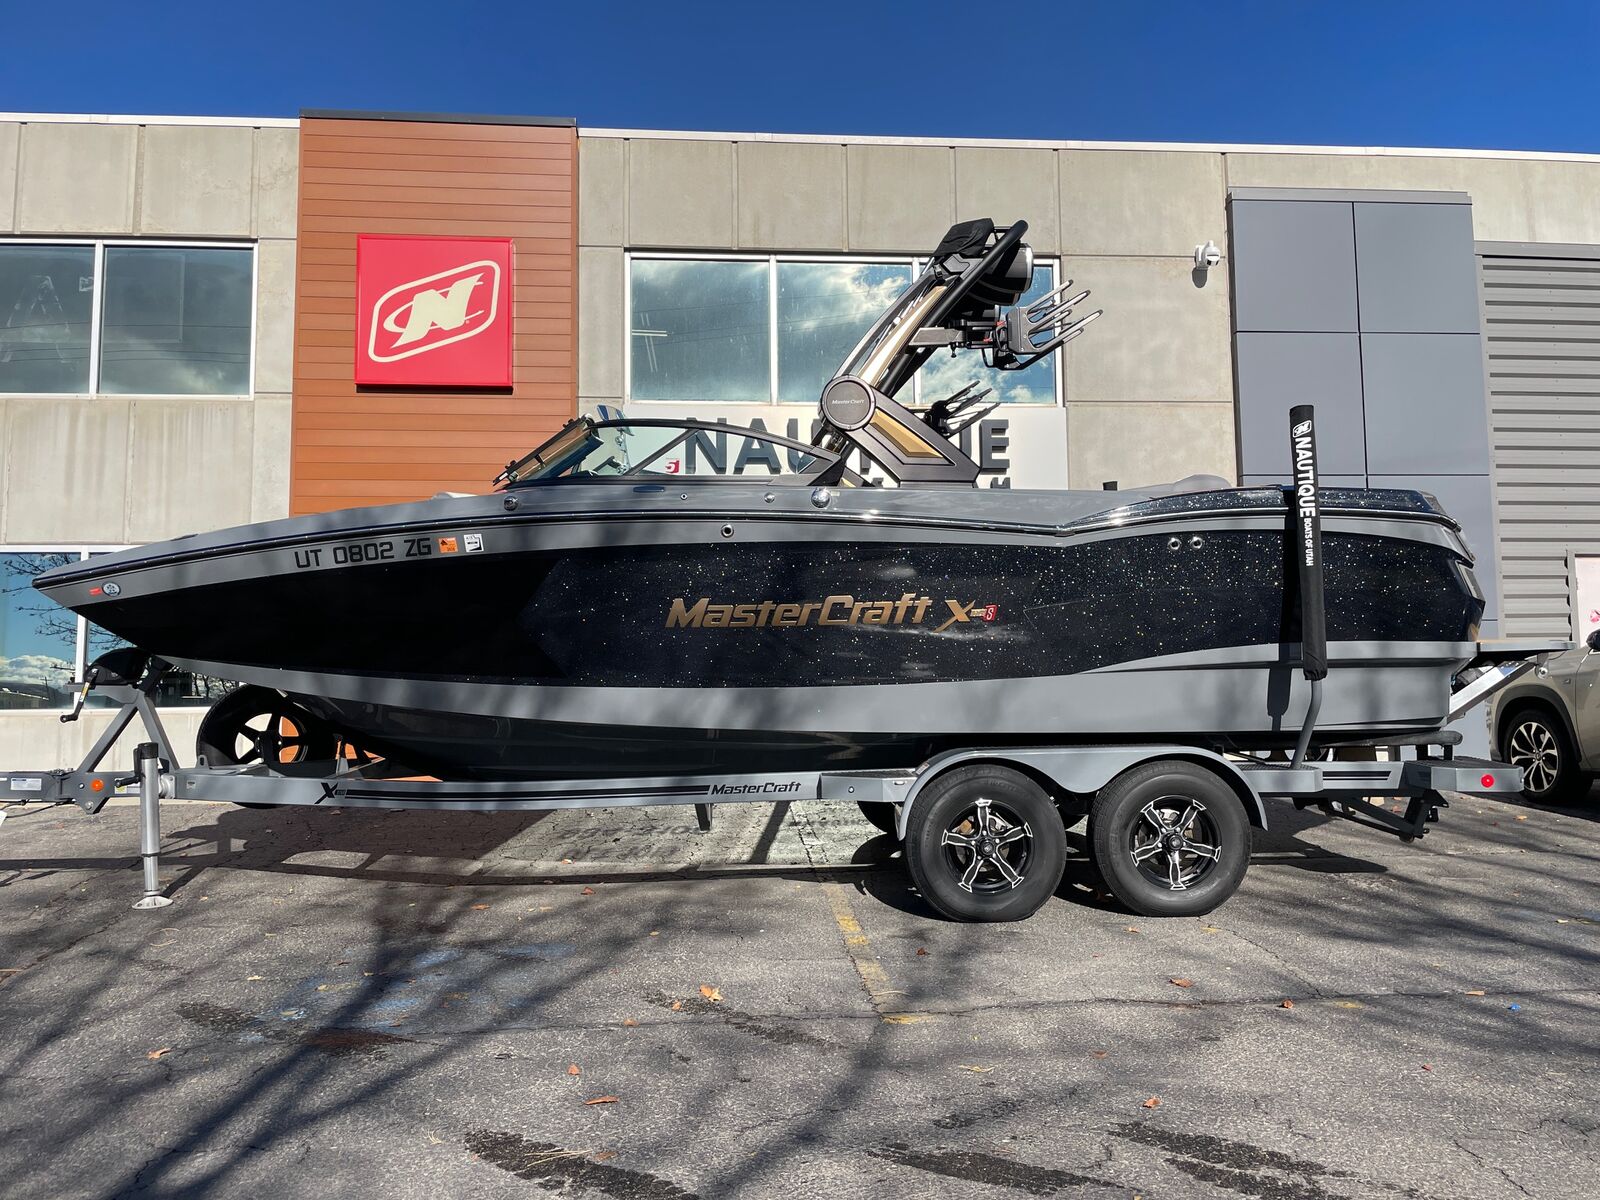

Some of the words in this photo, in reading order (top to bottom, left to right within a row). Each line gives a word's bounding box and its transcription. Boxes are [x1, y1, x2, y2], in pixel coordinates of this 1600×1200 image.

[1295, 436, 1316, 518] NAUTIQUE
[1304, 517, 1313, 539] BOATS
[294, 549, 322, 569] UT
[333, 541, 394, 565] 0802
[403, 537, 432, 558] ZG
[1305, 538, 1314, 549] OF
[1305, 548, 1314, 566] UTAH
[665, 593, 933, 628] MasterCraft
[711, 781, 802, 795] MasterCraft
